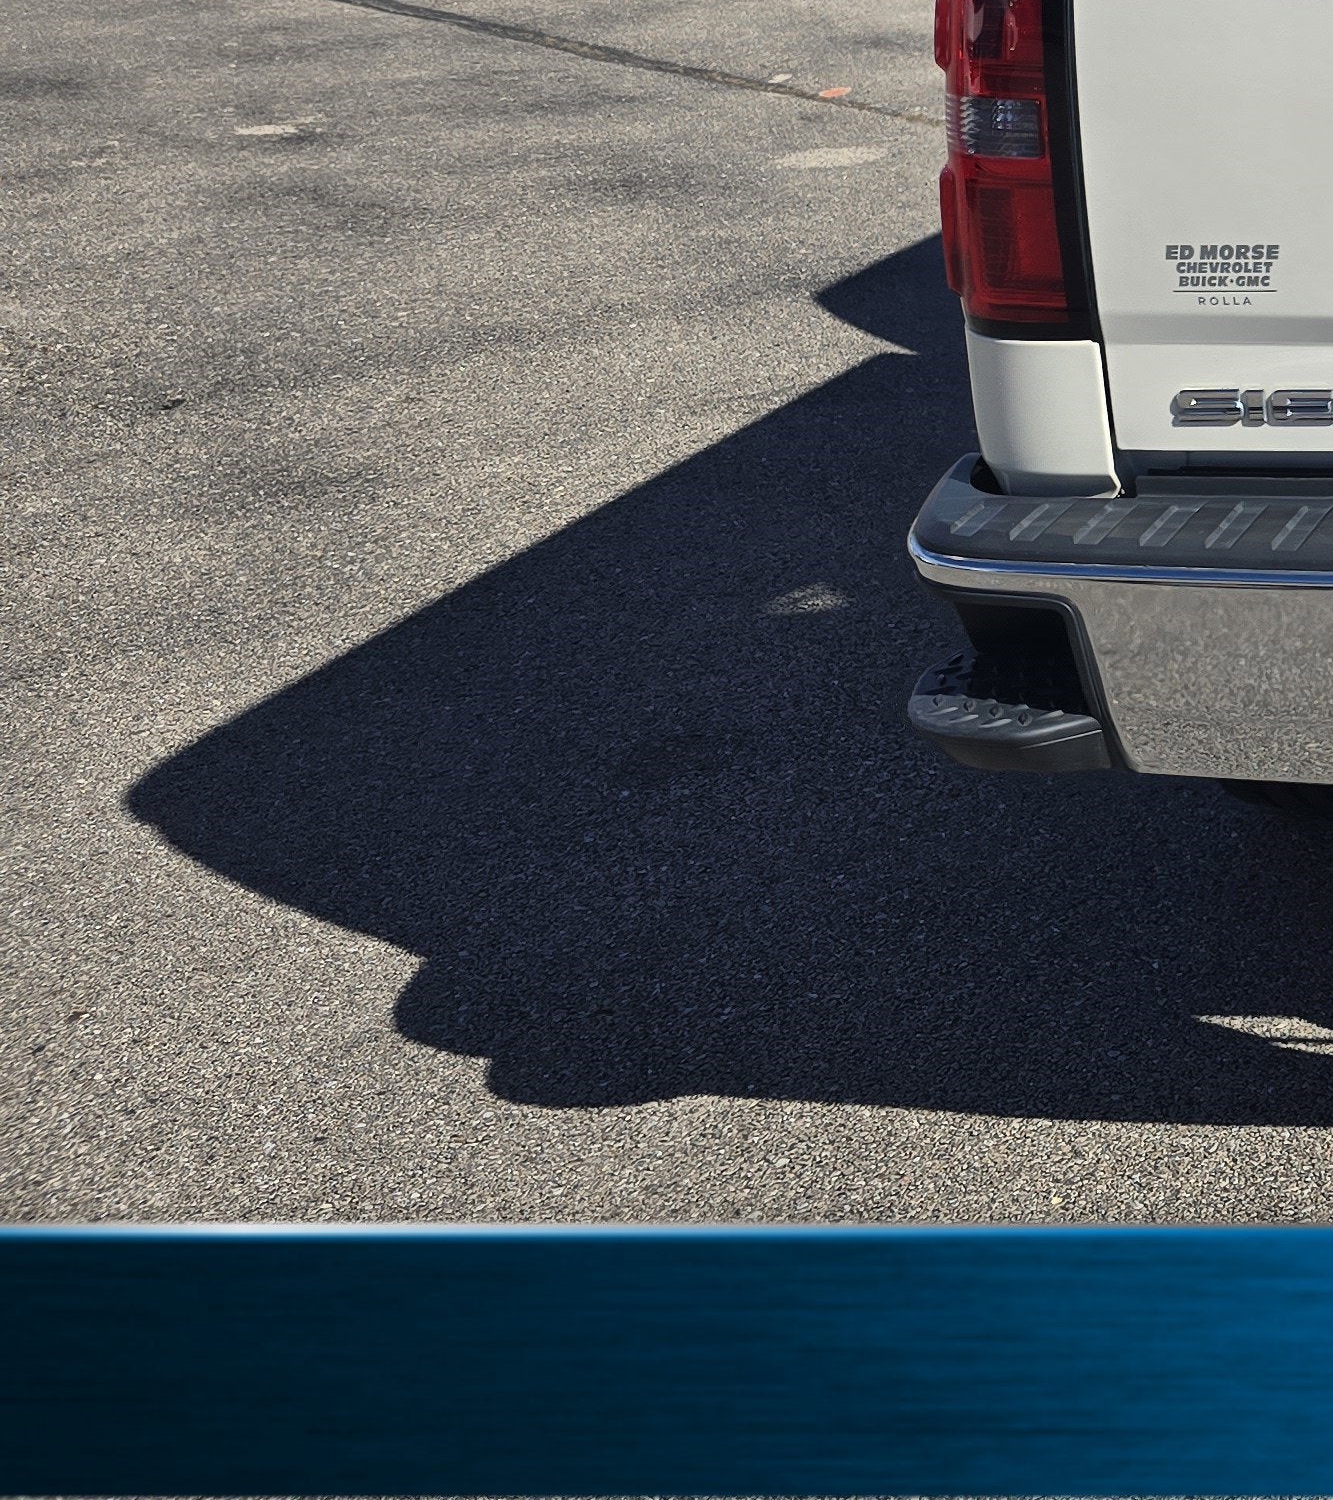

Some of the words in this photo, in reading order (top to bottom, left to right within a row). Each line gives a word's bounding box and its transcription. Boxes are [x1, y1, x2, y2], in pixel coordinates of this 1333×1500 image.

[1165, 244, 1195, 260] ED
[1199, 244, 1280, 260] MORSE
[1176, 261, 1274, 274] CHEVROLET
[1198, 296, 1252, 306] ROLLA
